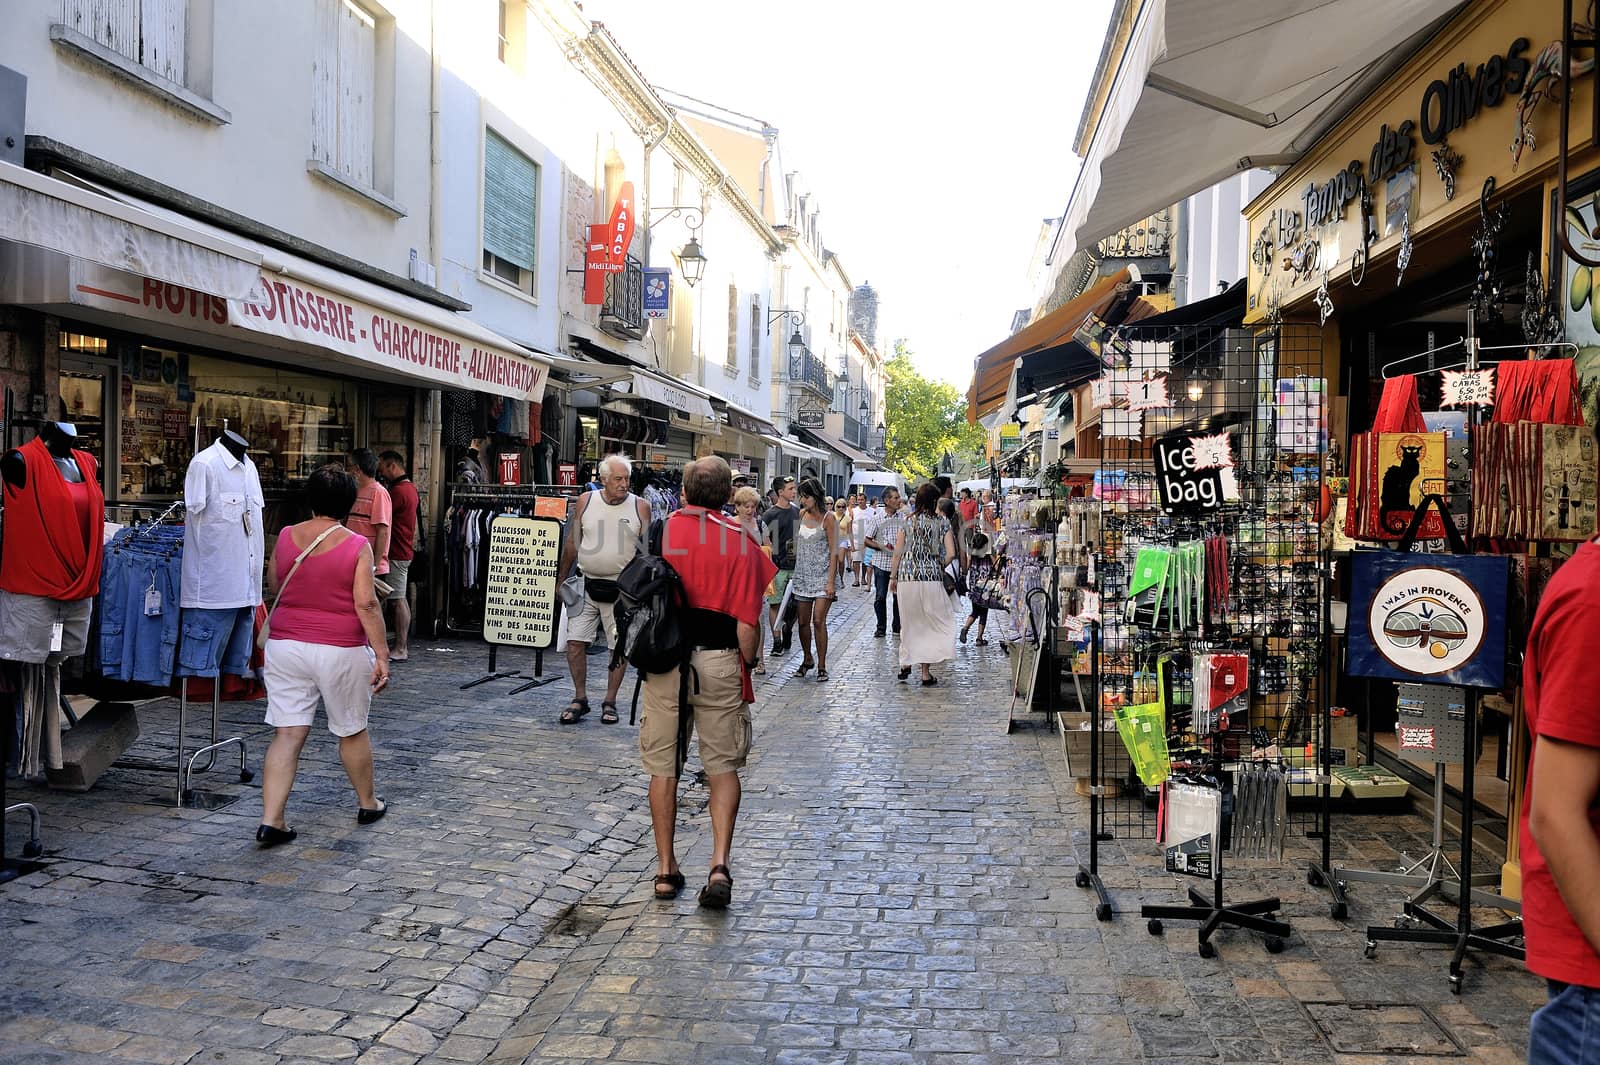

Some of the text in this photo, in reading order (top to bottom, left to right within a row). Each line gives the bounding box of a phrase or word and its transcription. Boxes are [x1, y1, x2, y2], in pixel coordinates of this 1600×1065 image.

[1302, 159, 1360, 233] Temps
[1369, 119, 1415, 184] des
[1420, 37, 1530, 145] Olives
[613, 199, 629, 255] TABAC
[371, 315, 460, 374] CHARCUTERIE
[468, 348, 541, 393] ALIMENTATION
[1160, 444, 1195, 472] Ice
[1164, 474, 1217, 508] bag
[493, 526, 547, 537] SAUCISSON DE
[491, 546, 545, 557] SAUCISSON DE
[490, 565, 503, 573] RIZ
[489, 575, 538, 586] FLEUR DE SEL
[488, 585, 508, 594] HUILE
[1385, 591, 1406, 607] WAS
[1407, 587, 1419, 596] IN
[1421, 586, 1472, 615] PROVENCE
[486, 619, 550, 633] VINS DES SABLES
[497, 632, 537, 643] FOIE GRAS
